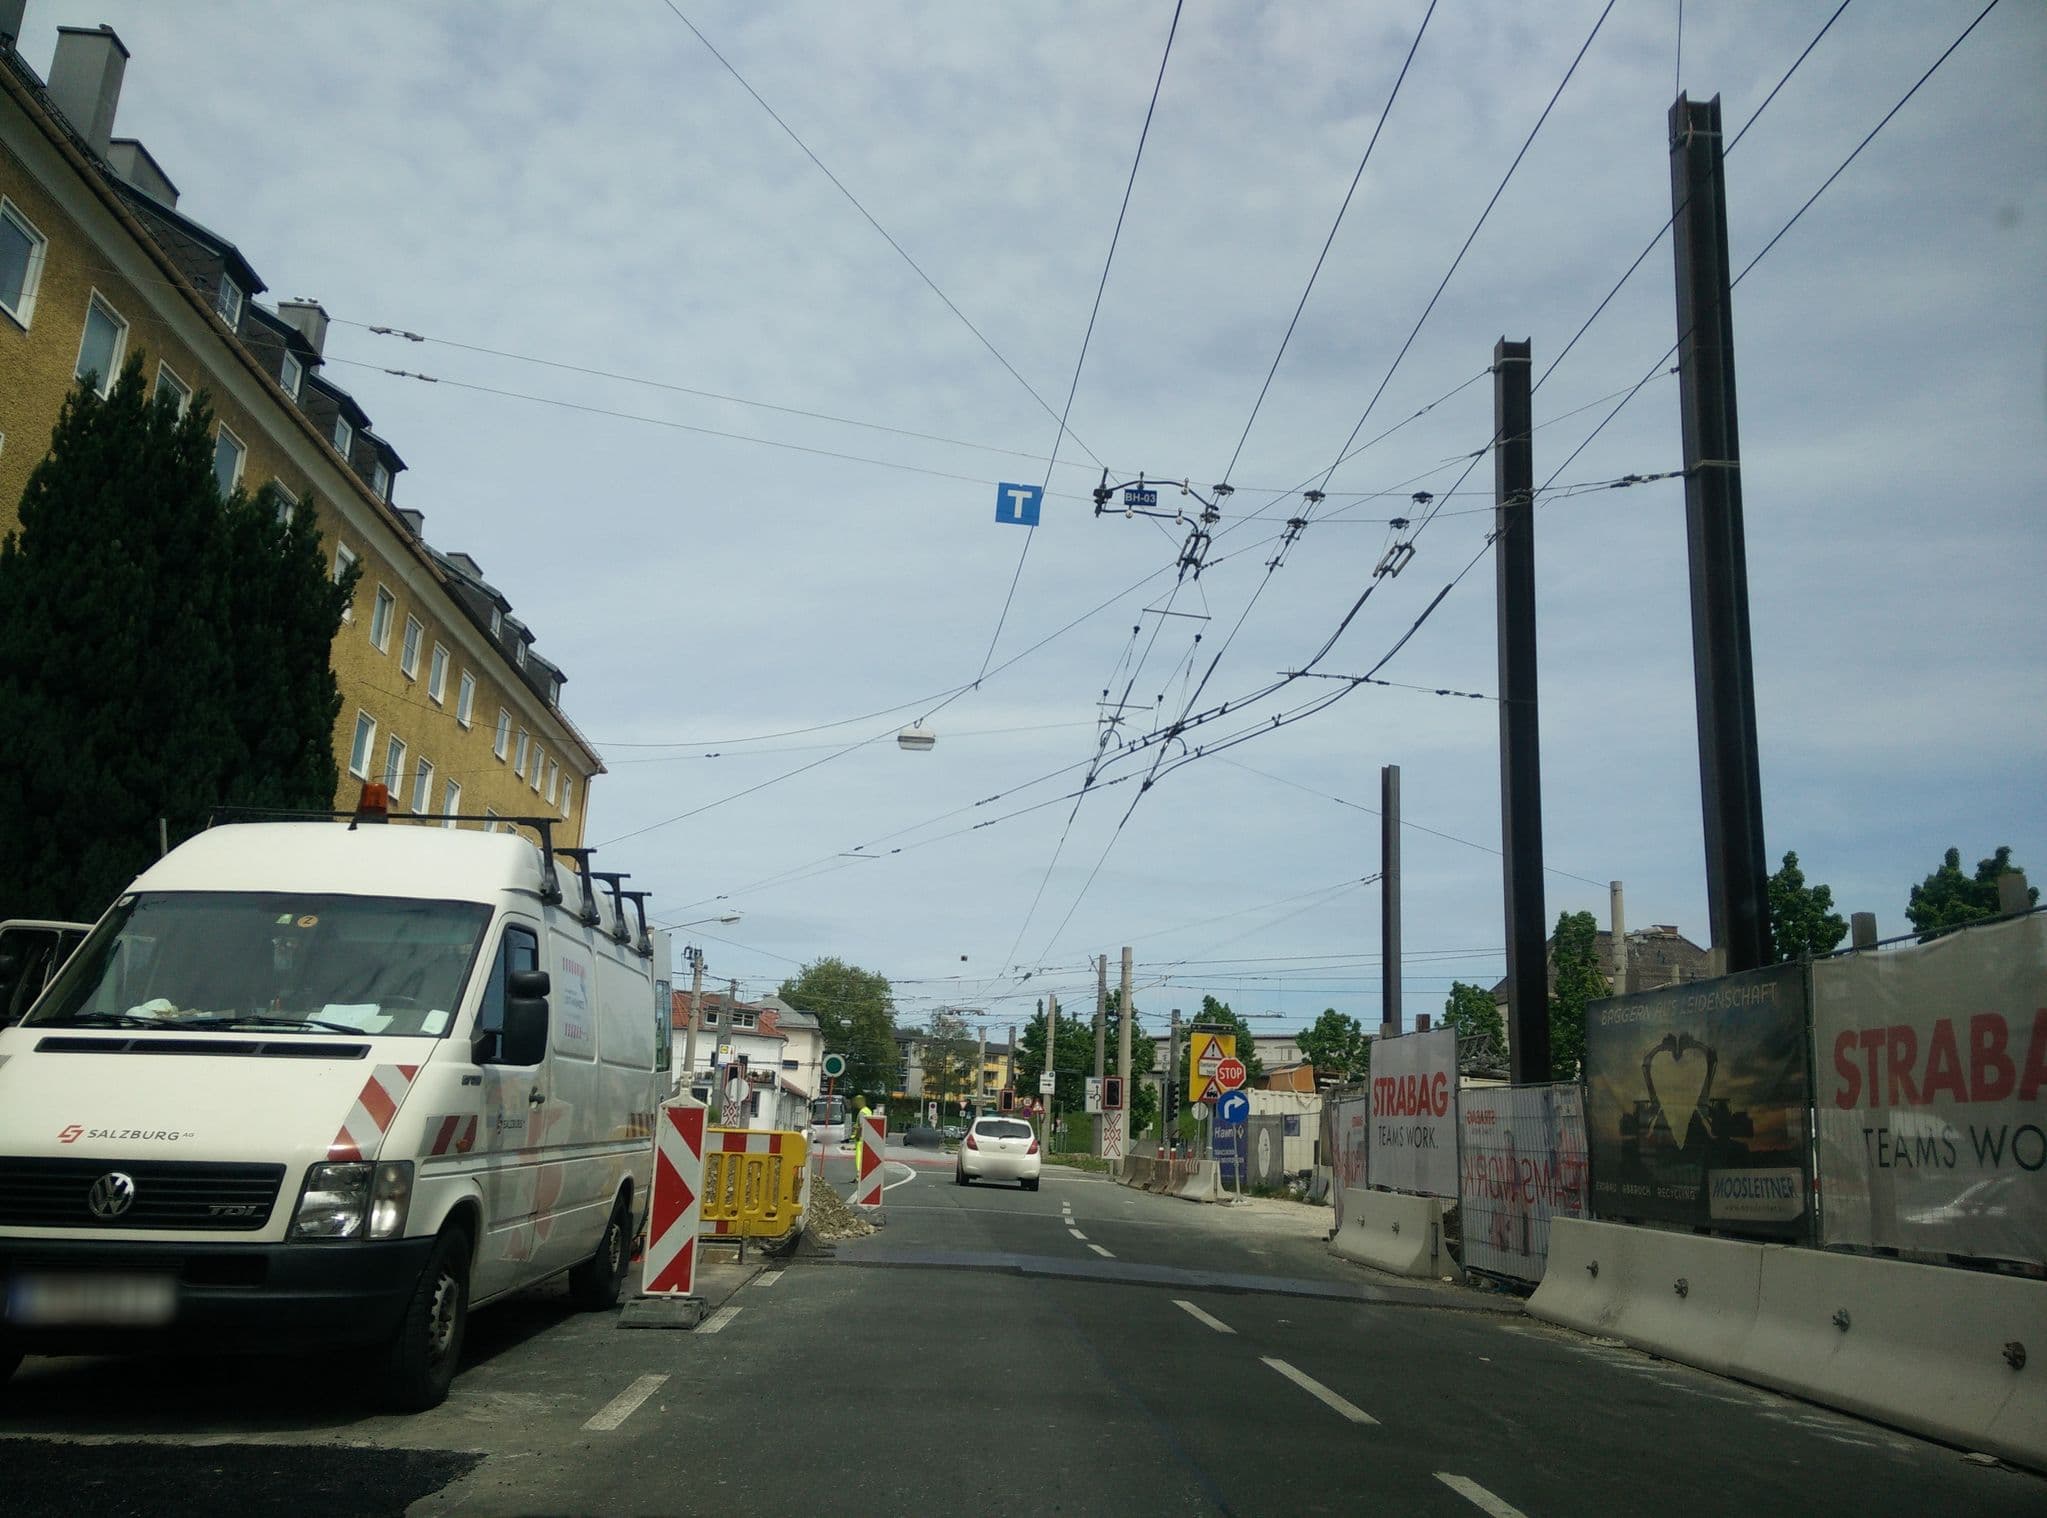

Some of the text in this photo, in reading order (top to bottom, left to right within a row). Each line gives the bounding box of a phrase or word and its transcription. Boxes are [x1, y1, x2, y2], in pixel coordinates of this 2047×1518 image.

[1006, 490, 1033, 519] T
[1124, 491, 1157, 505] BH-03
[1219, 1067, 1242, 1080] STOP
[1373, 1071, 1449, 1117] STRABAG
[87, 1129, 180, 1141] SALZBURG
[1378, 1125, 1439, 1149] TEAMS WORK.
[1862, 1125, 1957, 1169] TEAMS
[1712, 1176, 1794, 1199] MOOSLEITNER
[207, 1205, 257, 1216] TDI
